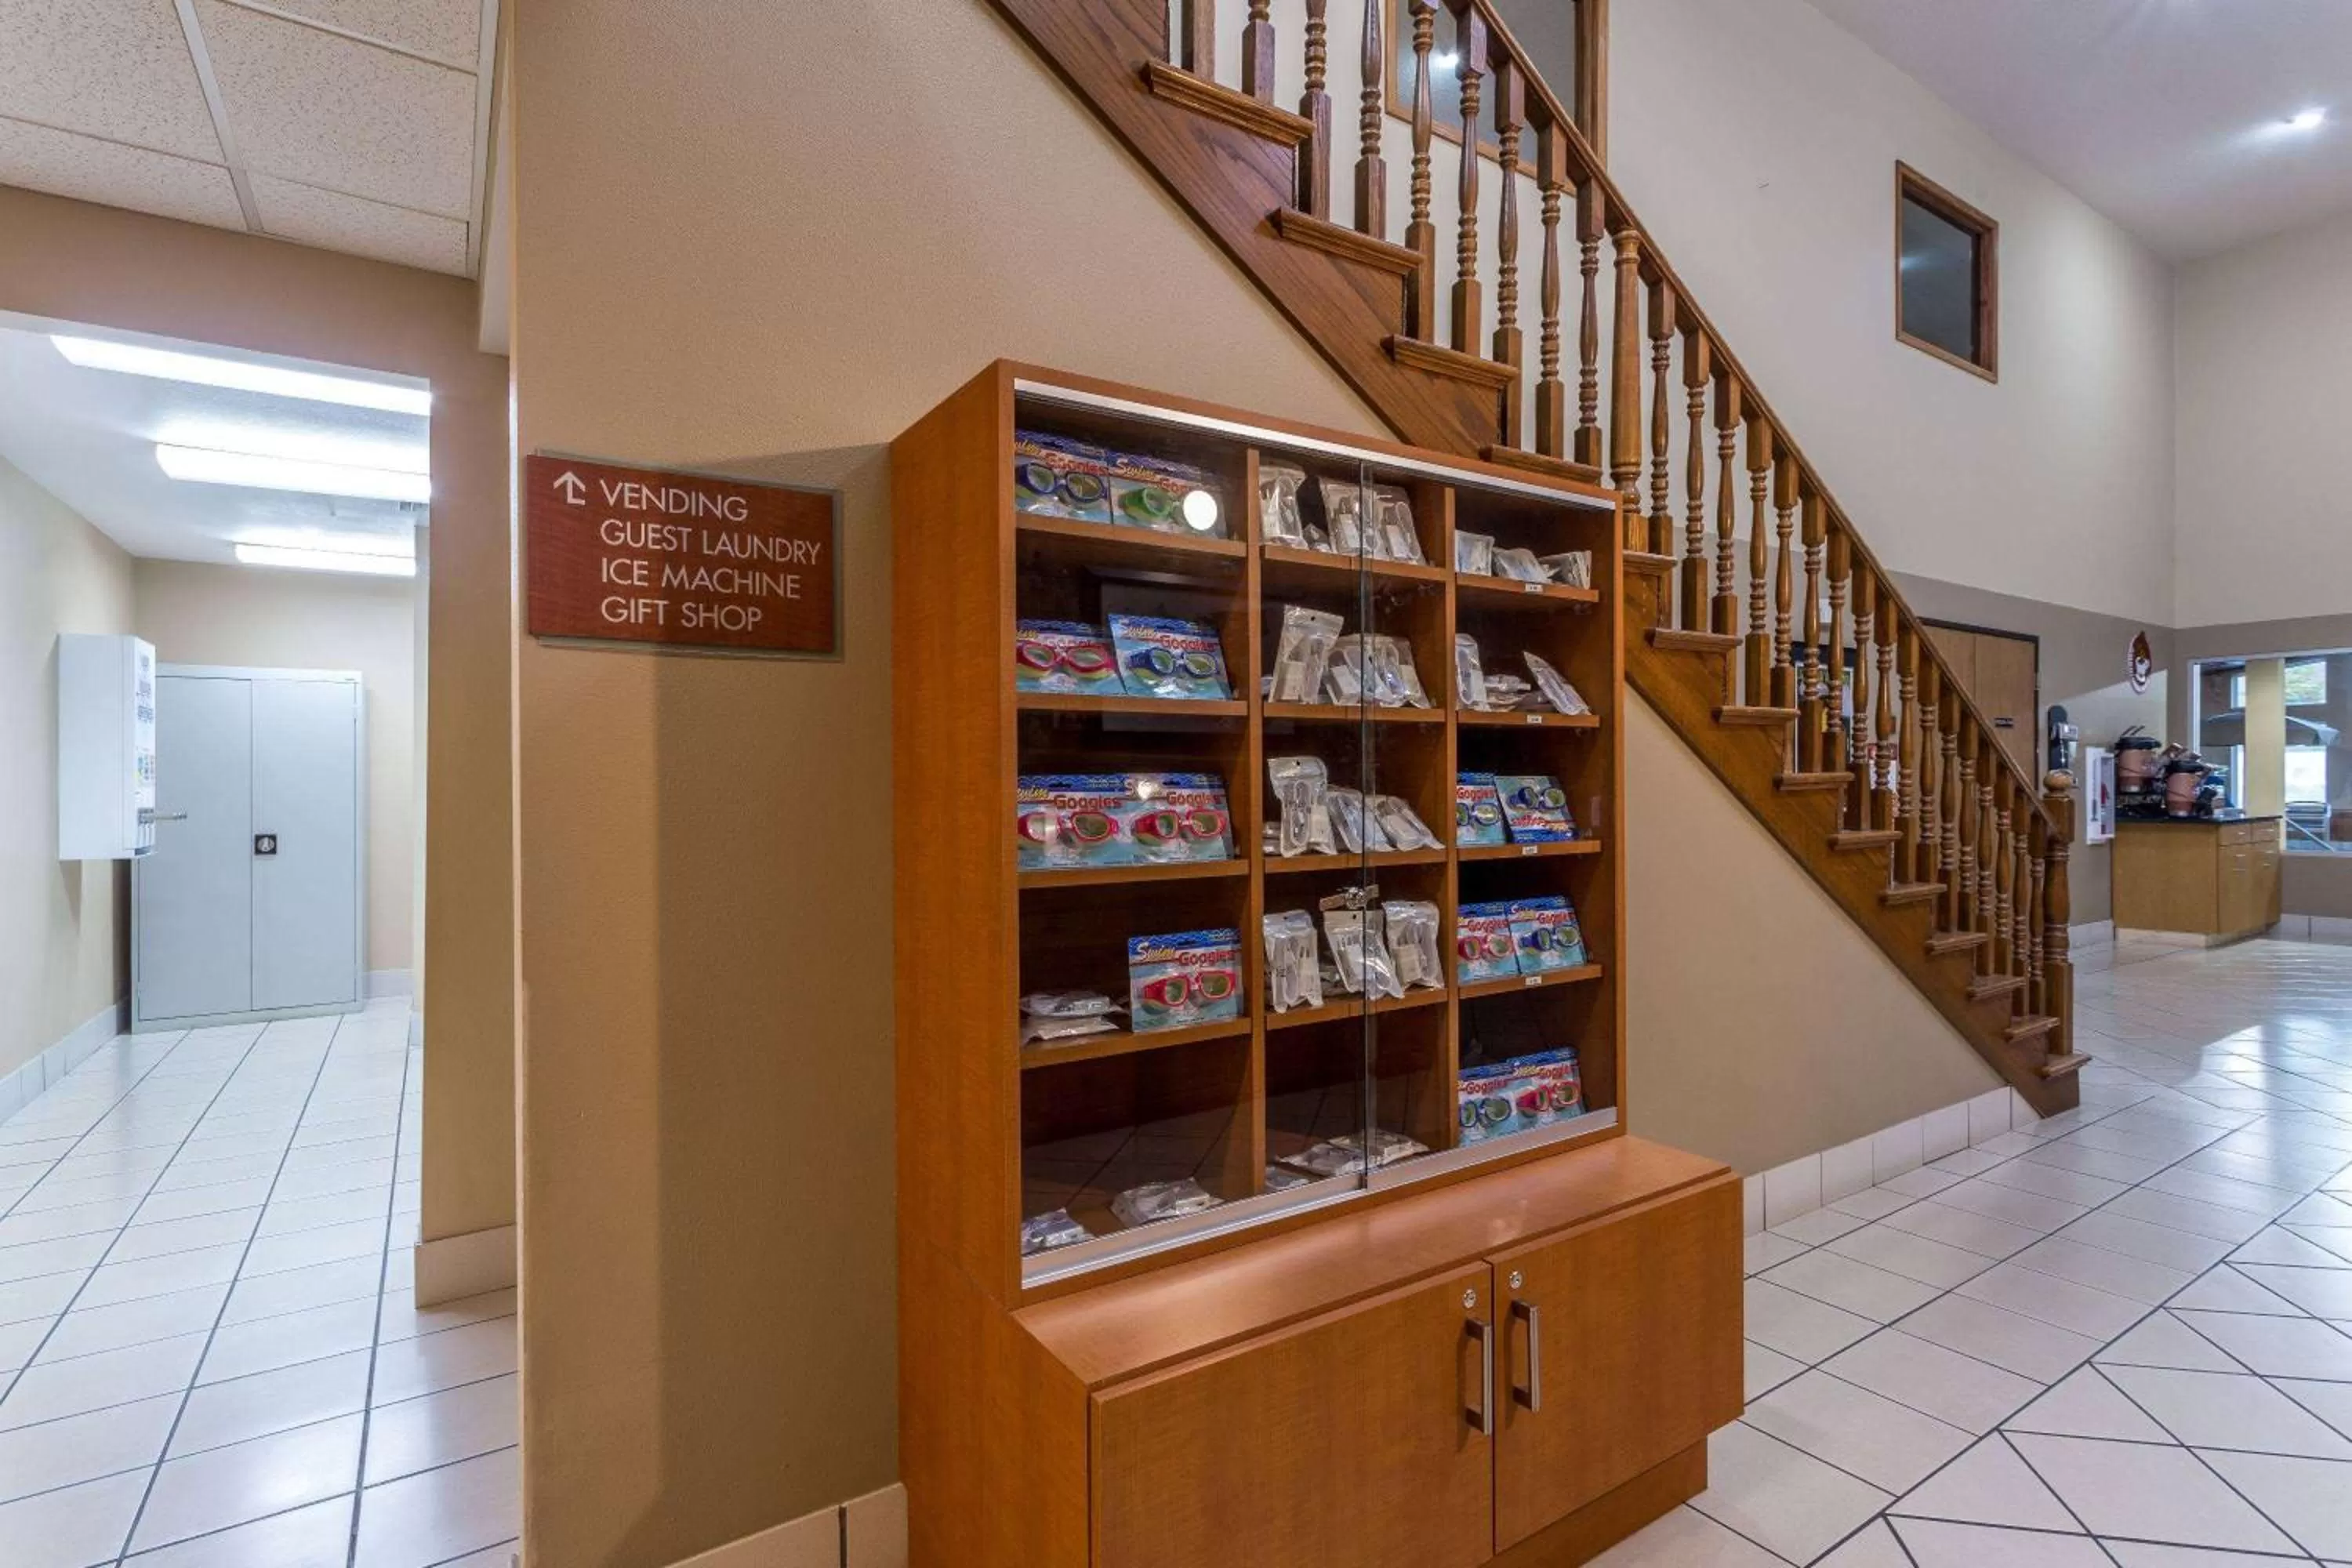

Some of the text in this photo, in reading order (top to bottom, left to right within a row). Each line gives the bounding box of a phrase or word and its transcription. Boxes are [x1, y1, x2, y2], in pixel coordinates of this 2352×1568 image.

[600, 479, 748, 521] VENDING
[601, 520, 821, 565] GUEST LAUNDRY
[602, 558, 800, 599] ICE MACHINE
[601, 596, 761, 630] GIFT SHOP
[1054, 794, 1121, 812] Goggles
